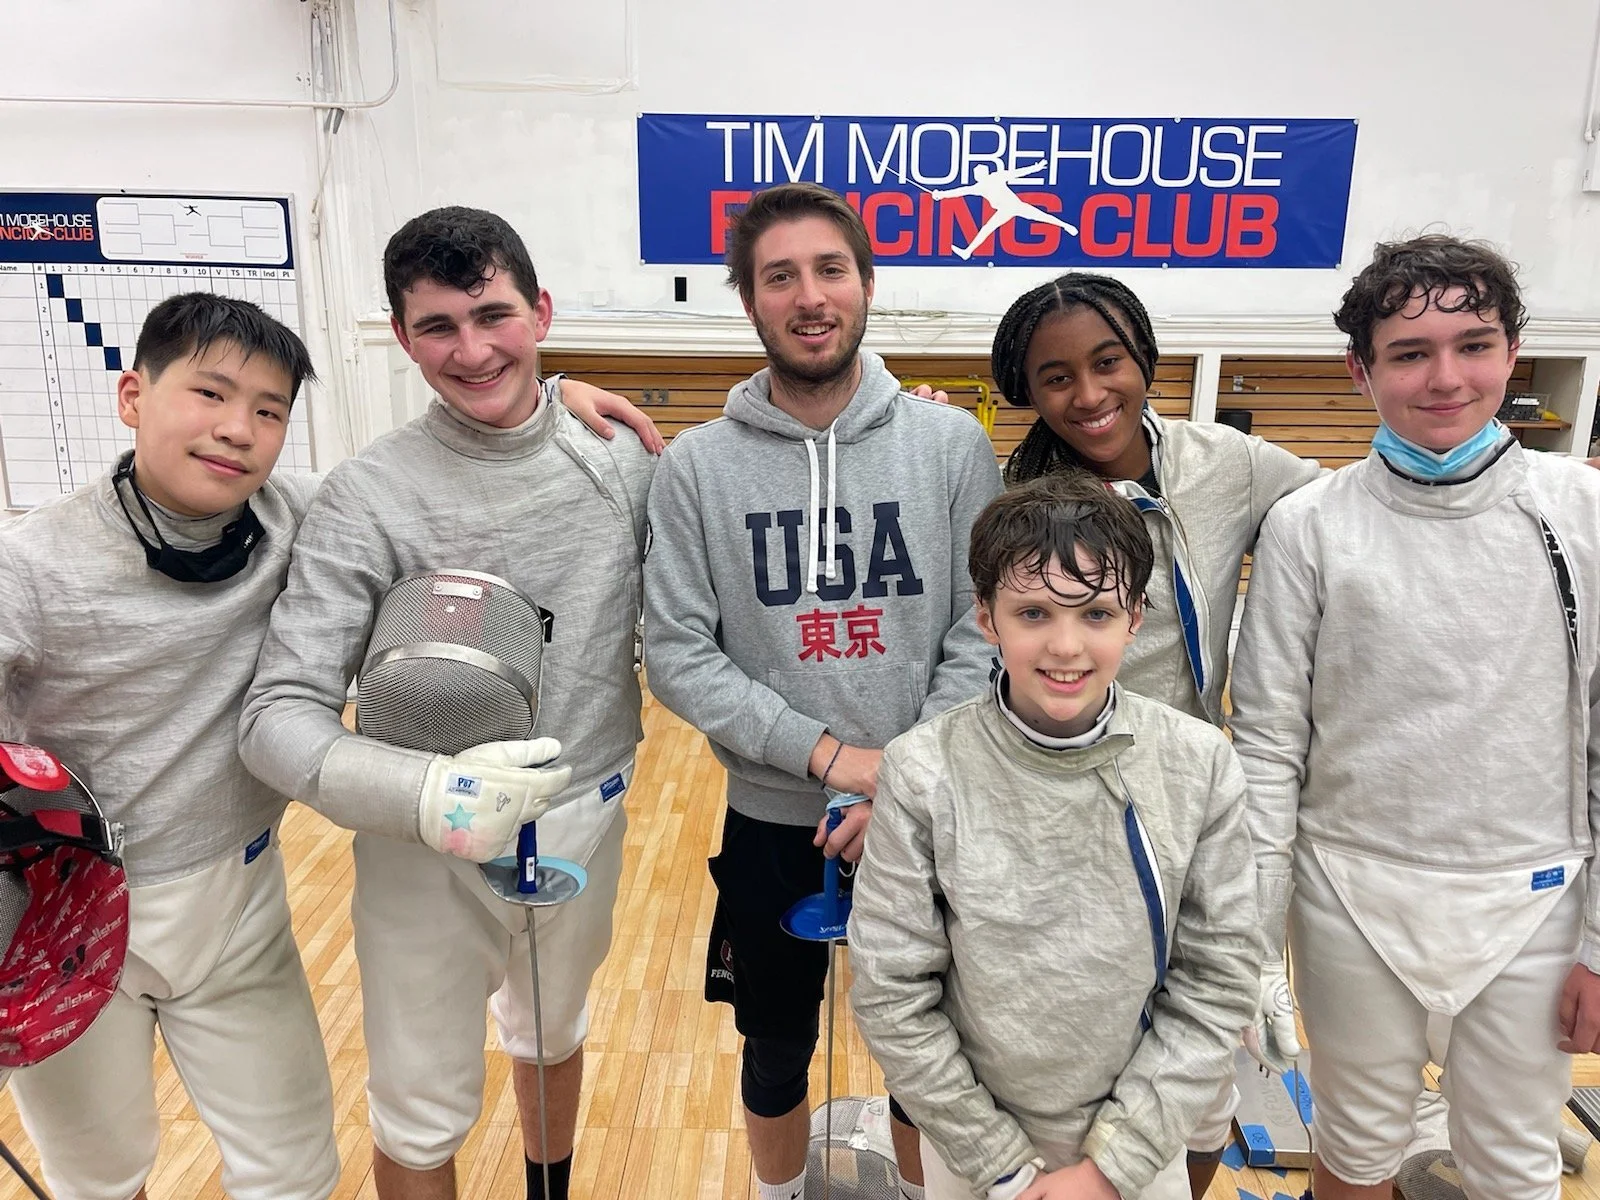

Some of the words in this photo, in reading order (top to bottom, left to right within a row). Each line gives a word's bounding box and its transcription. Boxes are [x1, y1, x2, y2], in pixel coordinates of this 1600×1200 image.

[706, 121, 823, 184] TIM
[848, 122, 1287, 189] MOREHOUSE
[0, 226, 51, 241] NCING
[53, 227, 94, 241] CLUB
[6, 213, 92, 227] MOREHOUSE
[711, 190, 1063, 258] FCING
[1078, 193, 1278, 258] CLUB
[745, 501, 924, 607] USA
[795, 603, 886, 662] 東京
